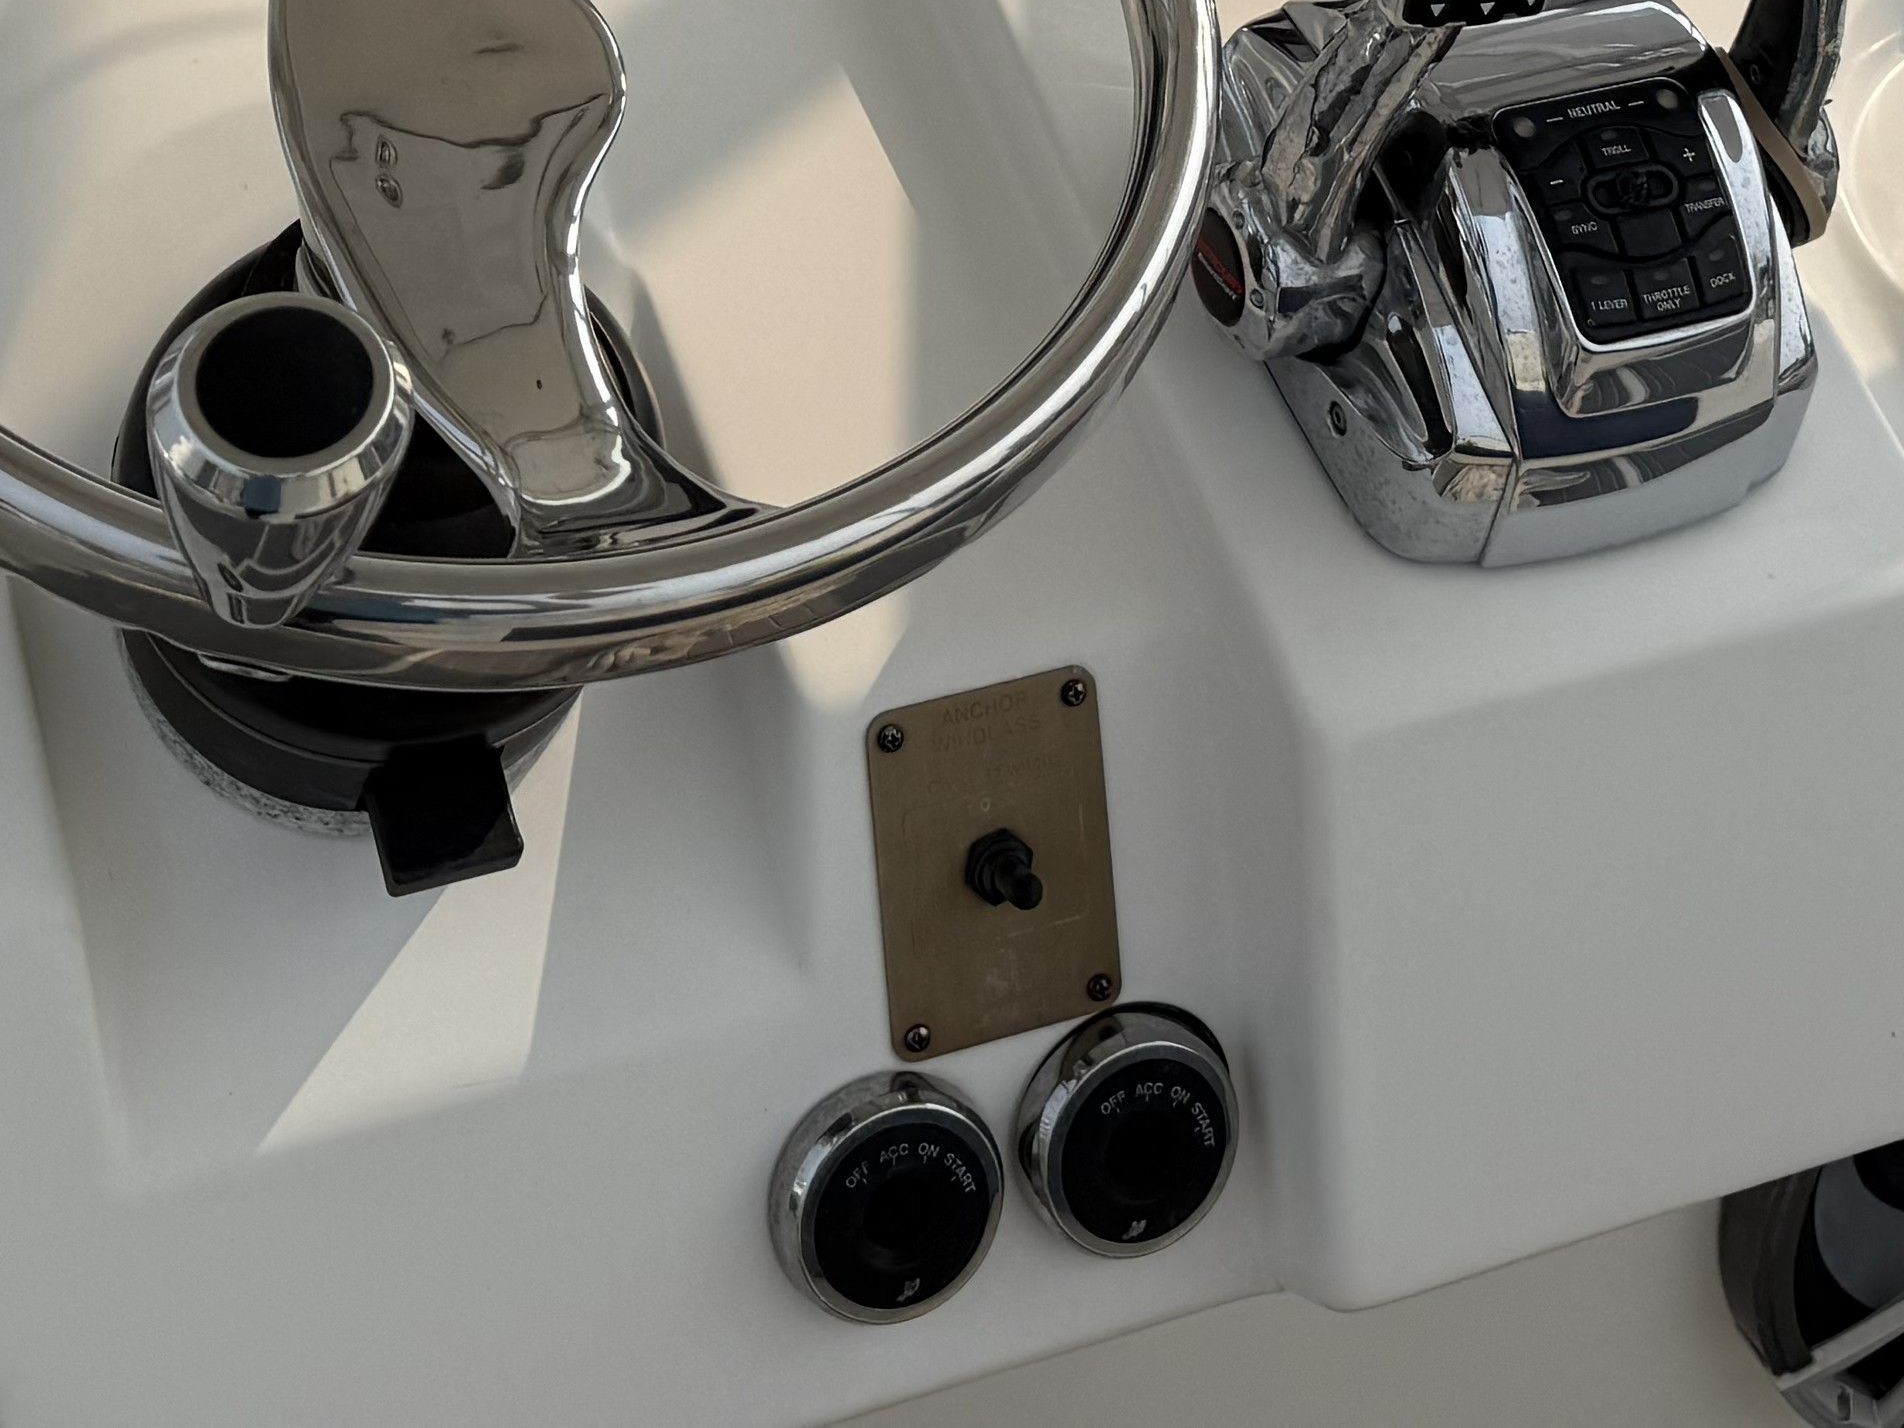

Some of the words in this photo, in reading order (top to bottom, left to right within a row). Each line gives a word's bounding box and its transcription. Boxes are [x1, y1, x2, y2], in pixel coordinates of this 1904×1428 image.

[1567, 100, 1621, 120] NEUTRAL
[1601, 144, 1632, 157] TROLL
[1710, 272, 1736, 288] DOCK
[1642, 284, 1691, 304] THROTTLE
[1598, 298, 1628, 312] LEVER
[1656, 298, 1682, 313] ONLY
[941, 691, 1029, 727] ANCHOR
[1100, 1090, 1126, 1115] OFF
[1134, 1082, 1165, 1098] ACC
[1170, 1086, 1192, 1105] ON
[1191, 1102, 1215, 1147] START
[845, 1161, 870, 1188] OFF
[879, 1143, 909, 1163] ACC
[917, 1142, 940, 1158] ON
[943, 1153, 977, 1193] START
